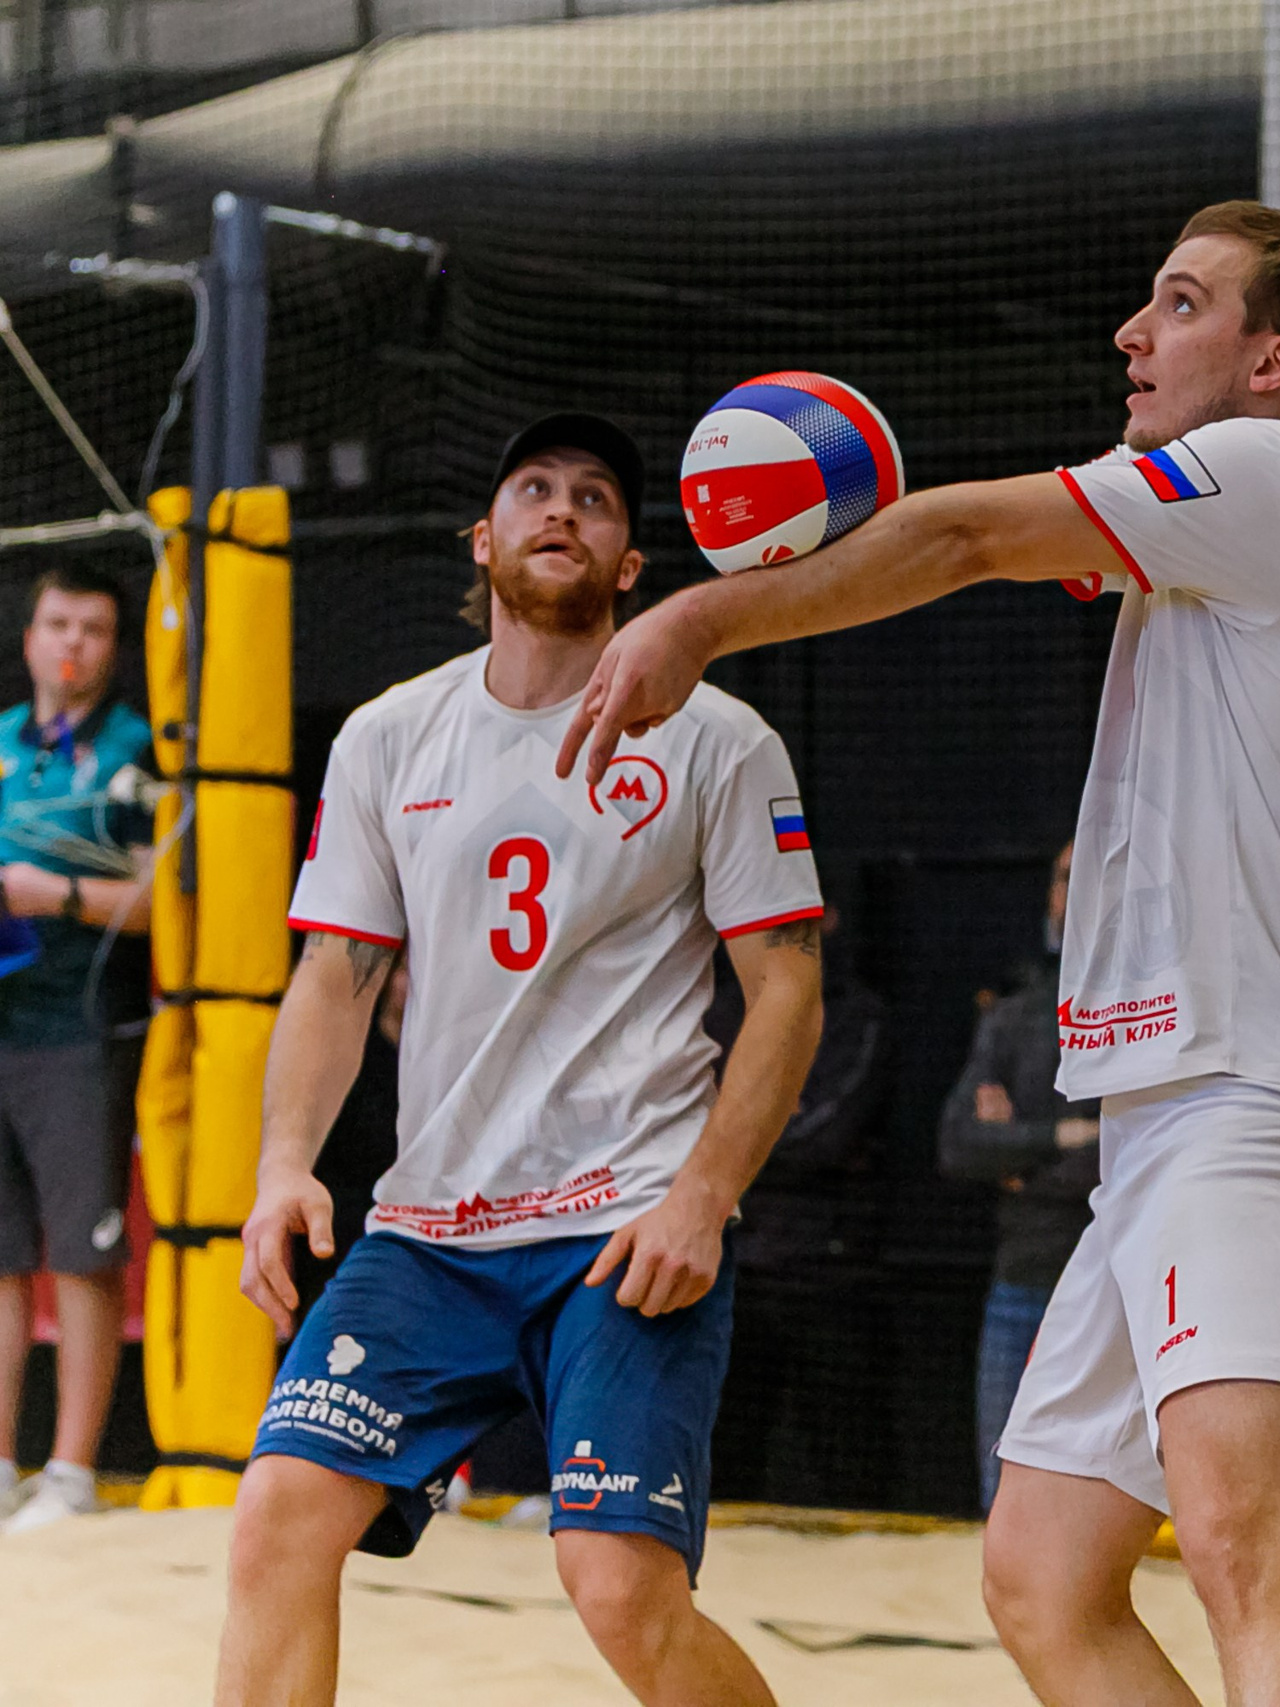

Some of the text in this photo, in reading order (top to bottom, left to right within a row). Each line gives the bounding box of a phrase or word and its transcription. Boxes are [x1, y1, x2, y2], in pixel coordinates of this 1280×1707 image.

[488, 836, 551, 972] 3
[1126, 1017, 1177, 1044] КЛУБ
[1165, 1264, 1176, 1327] 1
[271, 1378, 404, 1431] АКАДЕМИЯ
